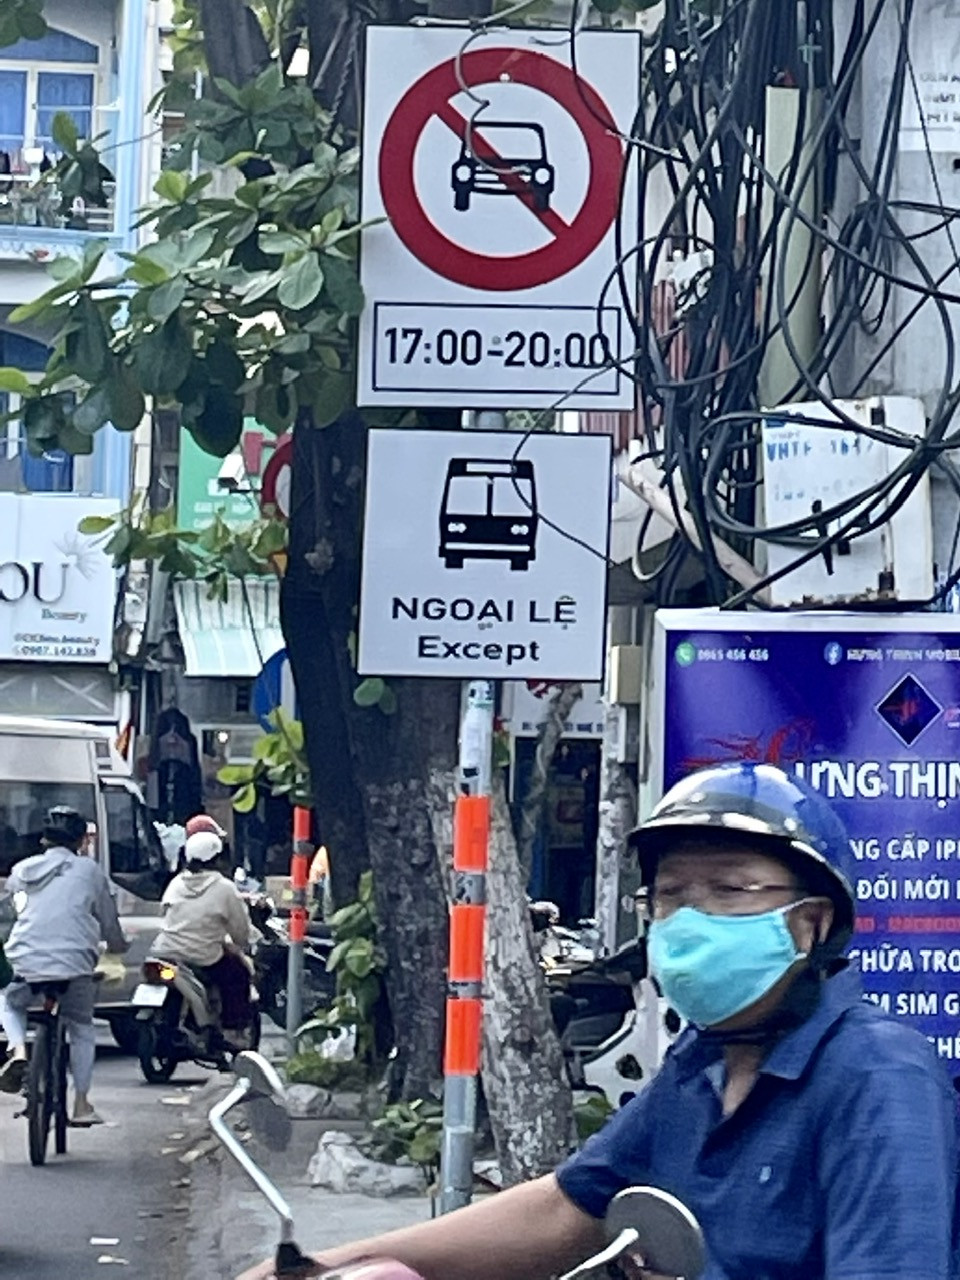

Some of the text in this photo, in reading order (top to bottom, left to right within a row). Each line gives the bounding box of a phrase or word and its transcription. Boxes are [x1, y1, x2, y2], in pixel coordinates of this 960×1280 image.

[385, 328, 610, 369] 17:00-20:00
[392, 595, 577, 630] NGOẠI LỆ
[418, 635, 540, 665] Except
[904, 873, 951, 900] MỚI
[896, 993, 938, 1015] SIM
